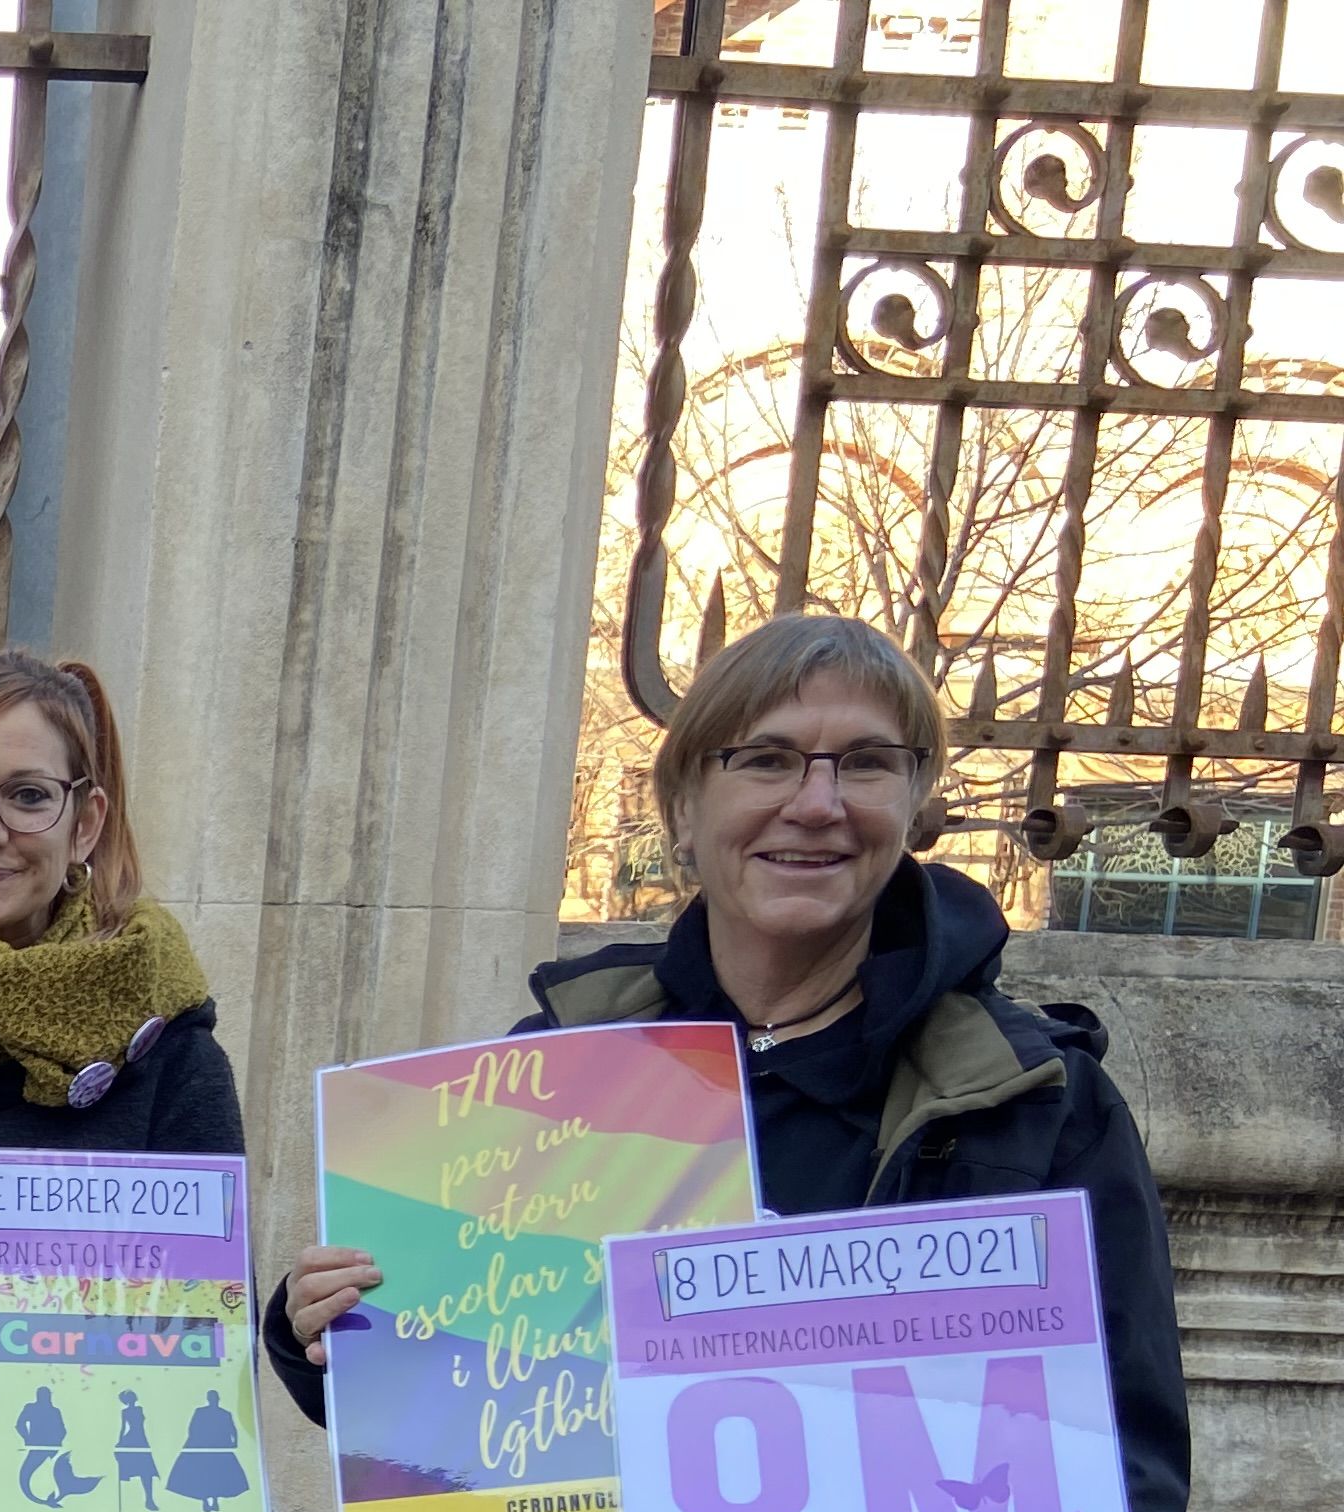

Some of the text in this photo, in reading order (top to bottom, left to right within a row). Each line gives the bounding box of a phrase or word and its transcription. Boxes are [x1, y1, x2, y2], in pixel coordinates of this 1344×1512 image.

[432, 1048, 555, 1127] 17M
[17, 1176, 121, 1214] FEBRER
[131, 1180, 201, 1216] 2021
[441, 1116, 591, 1210] per un
[459, 1180, 601, 1249] entorn
[395, 1252, 567, 1340] escolar
[673, 1227, 1019, 1301] 8 DE MARÇ 2021
[0, 1319, 226, 1359] Carnaval
[645, 1306, 1065, 1363] DIA INTERNACIONAL DE LES DONES
[452, 1354, 471, 1387] i
